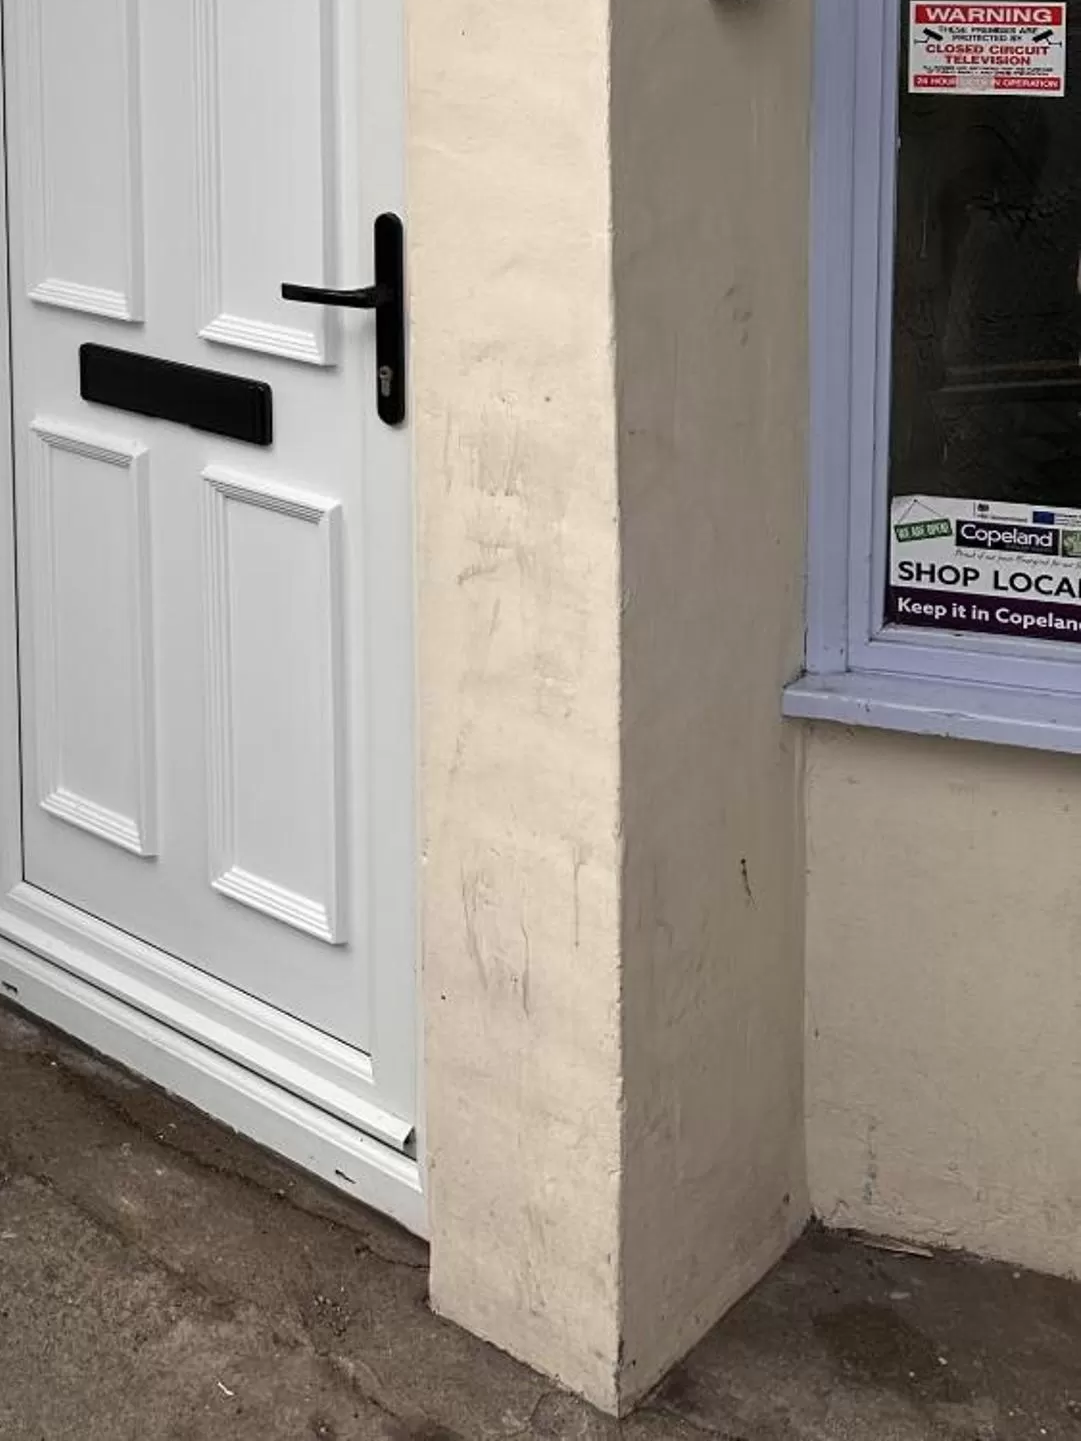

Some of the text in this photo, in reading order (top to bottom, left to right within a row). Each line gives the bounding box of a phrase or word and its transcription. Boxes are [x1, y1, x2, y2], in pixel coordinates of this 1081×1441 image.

[925, 7, 1053, 23] WARNING
[925, 44, 1051, 55] CLOSED CIRCUIT
[945, 55, 1031, 66] TELEVISION
[1002, 78, 1059, 89] OPERATION
[961, 523, 1053, 547] Copeland
[898, 560, 980, 587] SHOP
[898, 597, 948, 619] Keep
[952, 603, 967, 619] it
[971, 605, 989, 621] in
